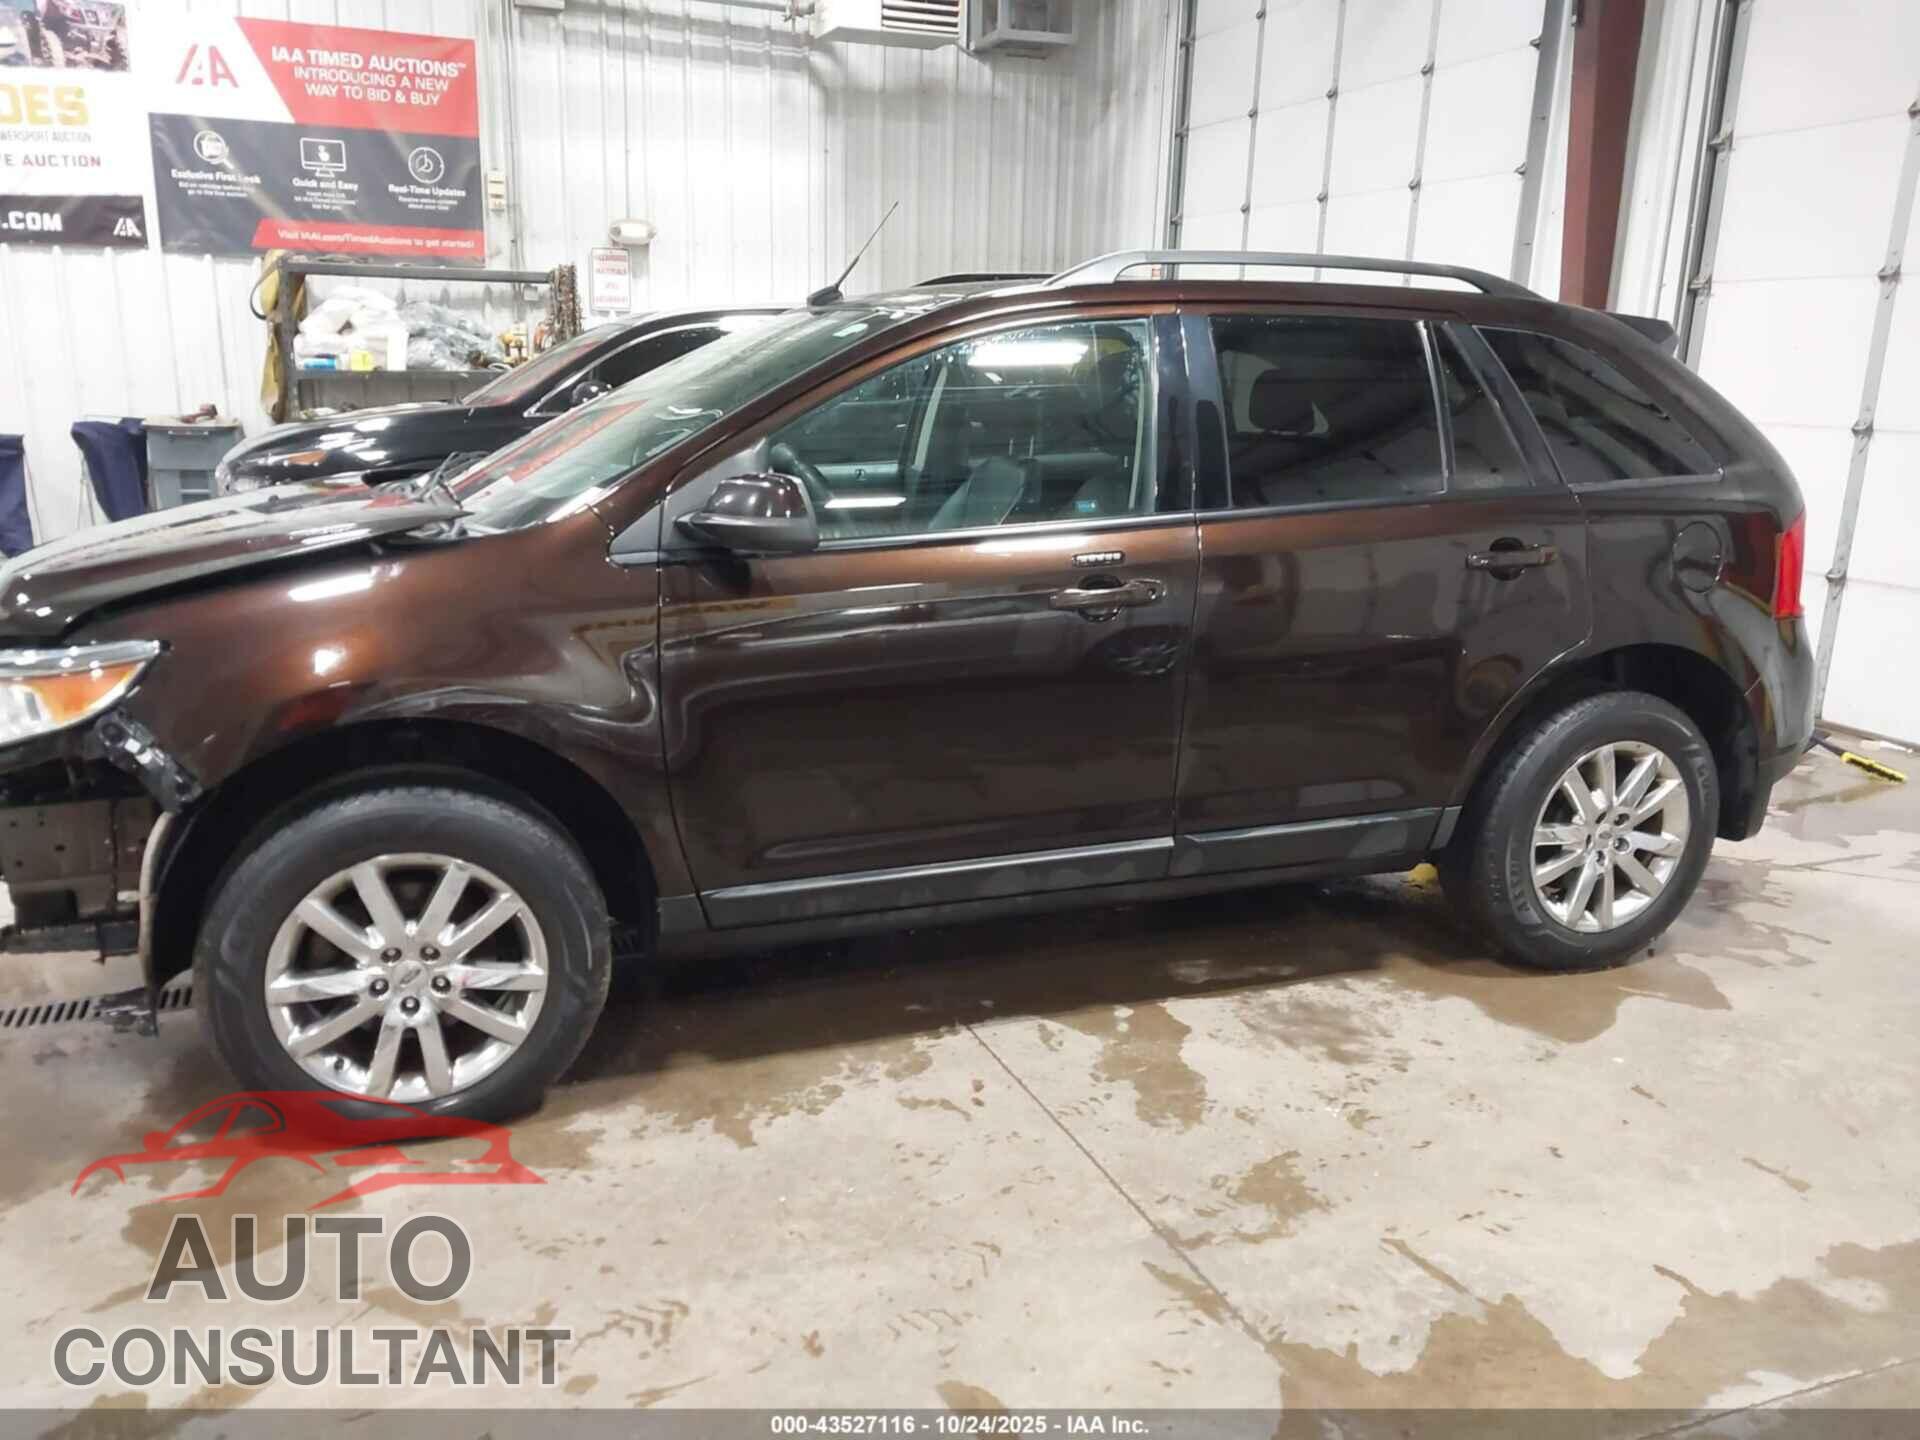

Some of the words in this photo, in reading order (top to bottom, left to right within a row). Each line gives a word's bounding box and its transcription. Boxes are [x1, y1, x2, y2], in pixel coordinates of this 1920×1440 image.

[271, 46, 304, 64] IAA
[306, 49, 364, 68] TIMED
[294, 66, 396, 87] INTRODUCING
[400, 75, 411, 88] A
[415, 77, 449, 91] NEW
[304, 83, 338, 97] WAY
[342, 86, 363, 99] TO
[367, 88, 391, 102] BID
[395, 90, 406, 103] &
[410, 92, 440, 105] BUY
[22, 154, 101, 167] AUCTION
